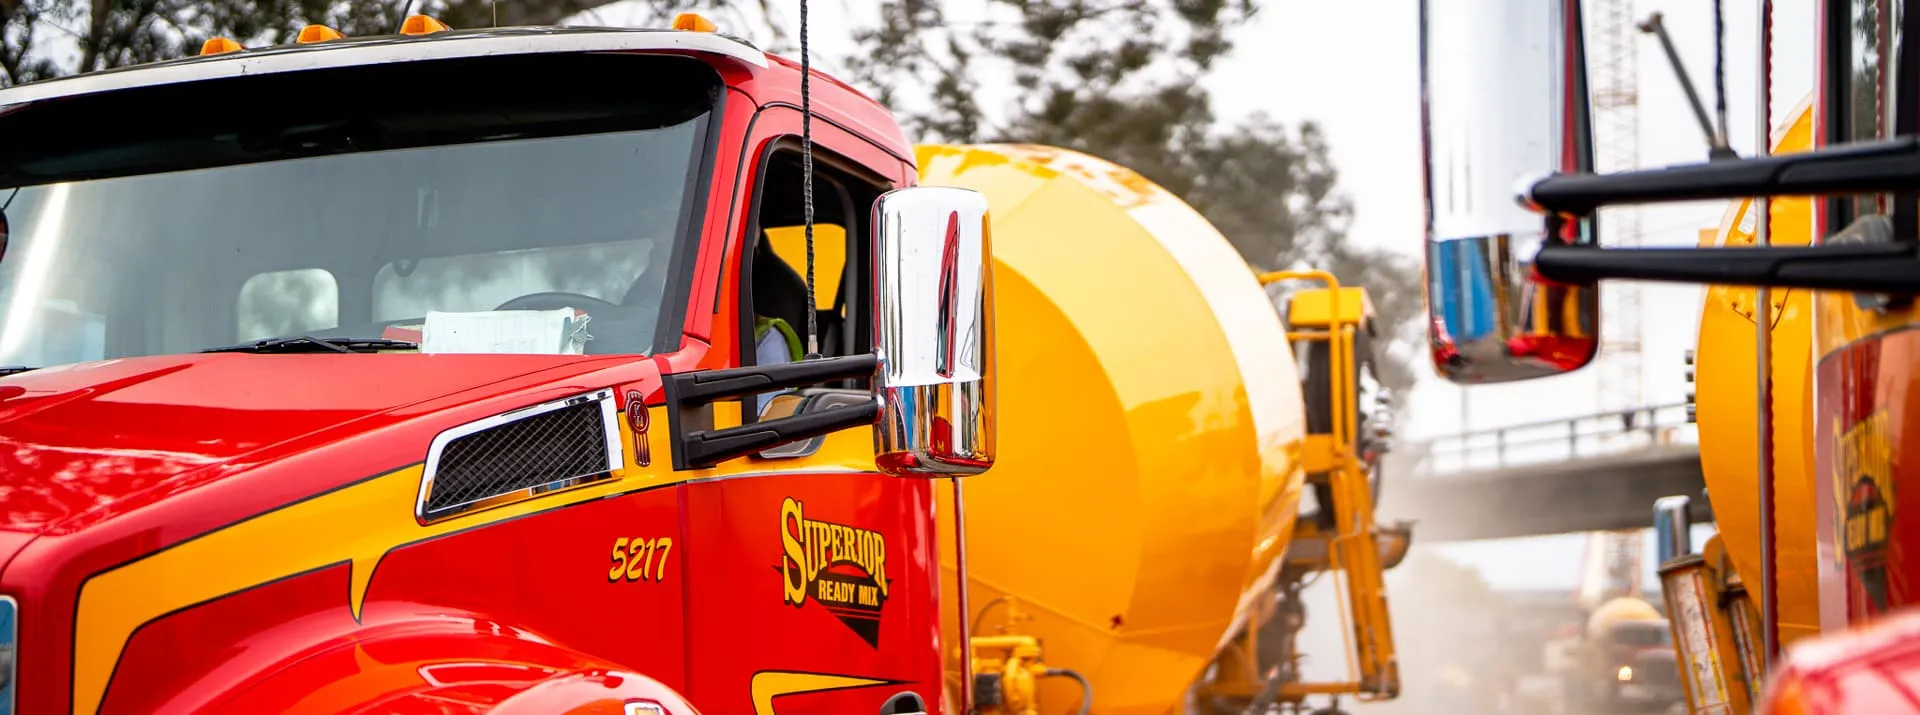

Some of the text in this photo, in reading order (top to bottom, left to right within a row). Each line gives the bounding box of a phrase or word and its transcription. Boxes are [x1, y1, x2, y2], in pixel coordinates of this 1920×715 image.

[609, 537, 672, 581] 5217
[781, 497, 888, 604] SUPERIOR
[818, 580, 879, 606] READY MIX
